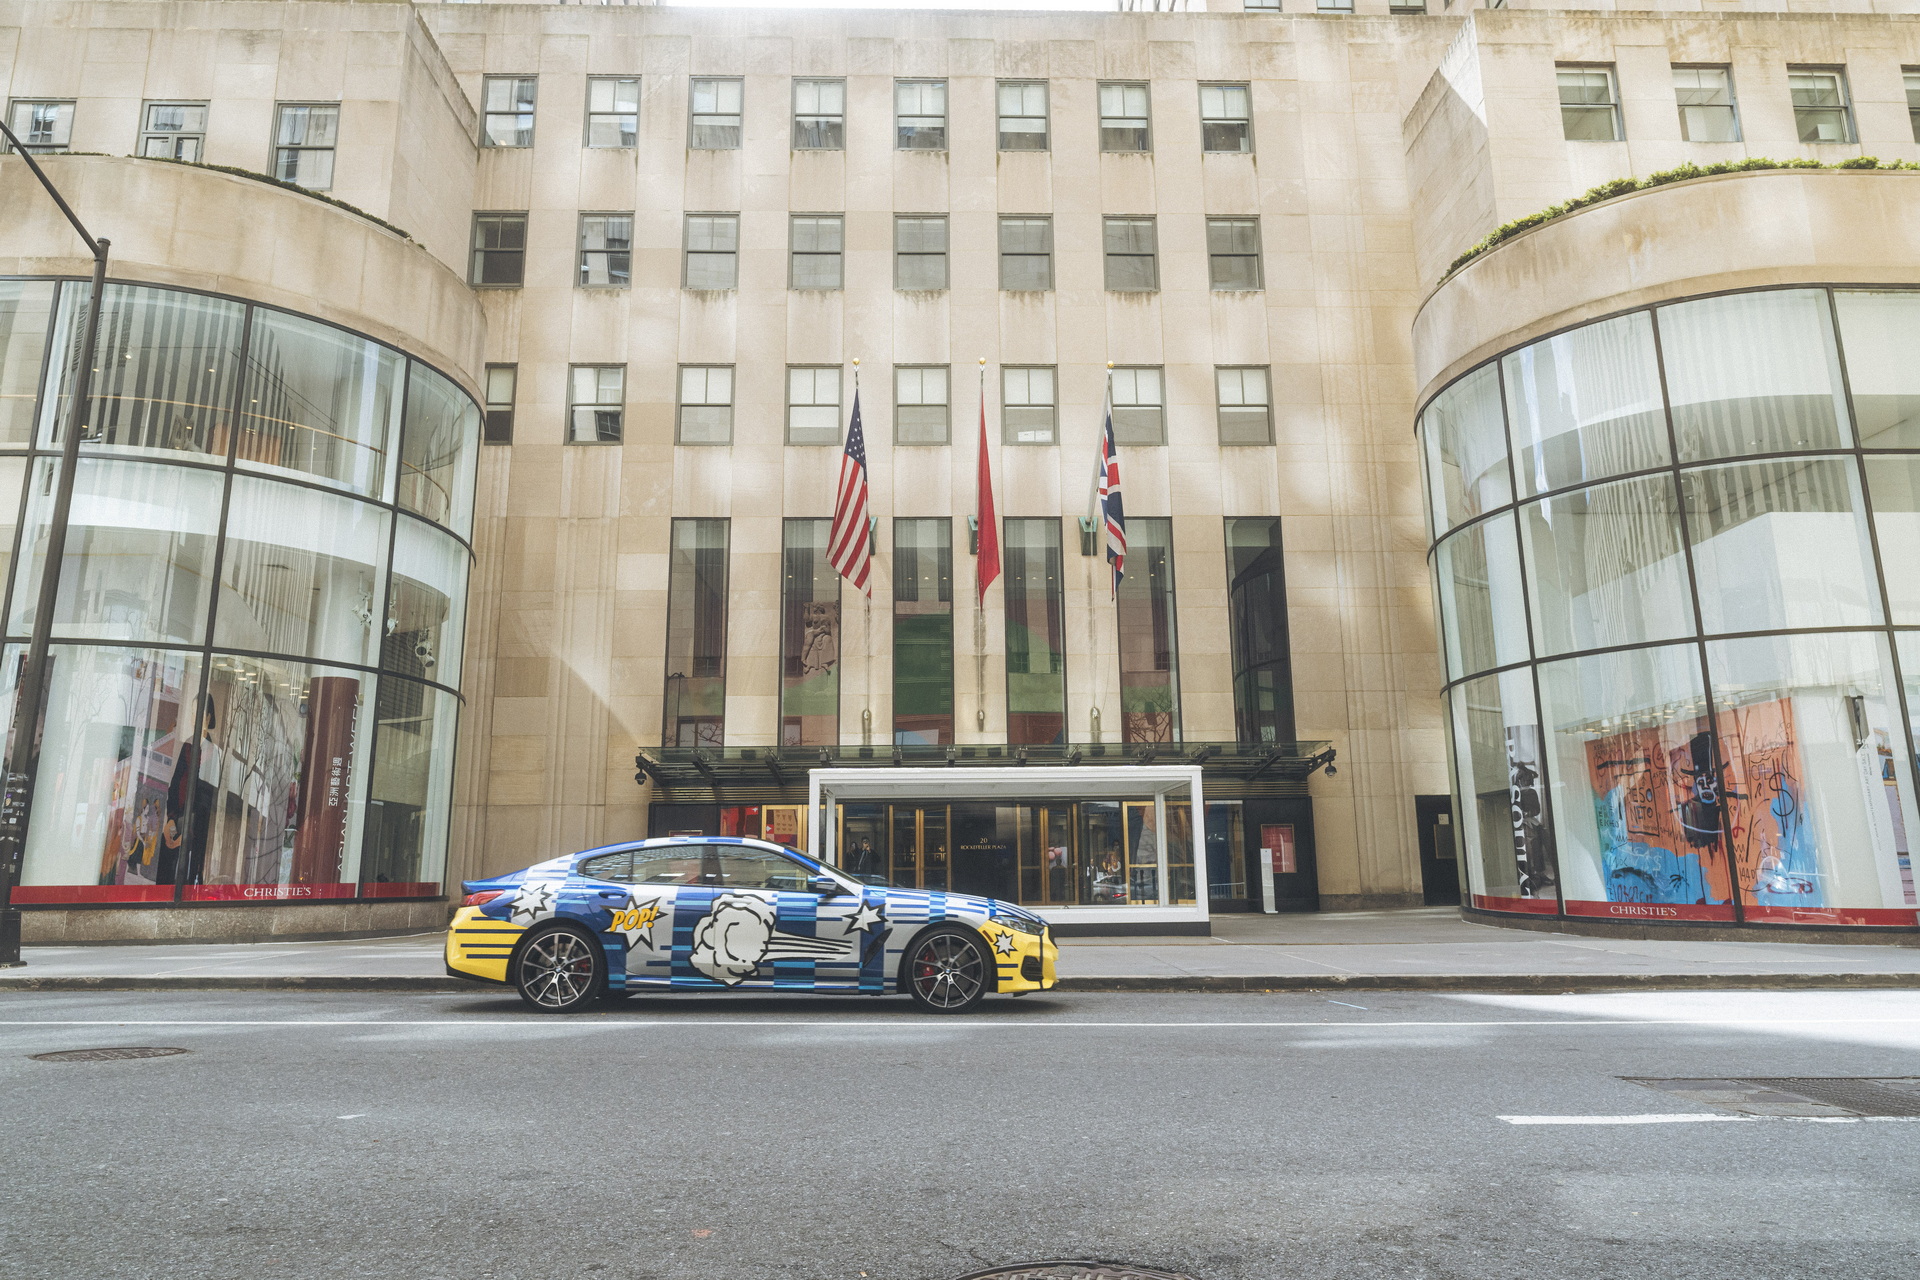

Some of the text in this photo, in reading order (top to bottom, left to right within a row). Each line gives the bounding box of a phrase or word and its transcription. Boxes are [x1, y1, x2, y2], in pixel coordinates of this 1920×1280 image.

[1629, 805, 1654, 824] NETO
[243, 887, 312, 897] CHRISTIE'S
[1610, 905, 1677, 916] CHRISTIE'S
[610, 906, 660, 932] POP!
